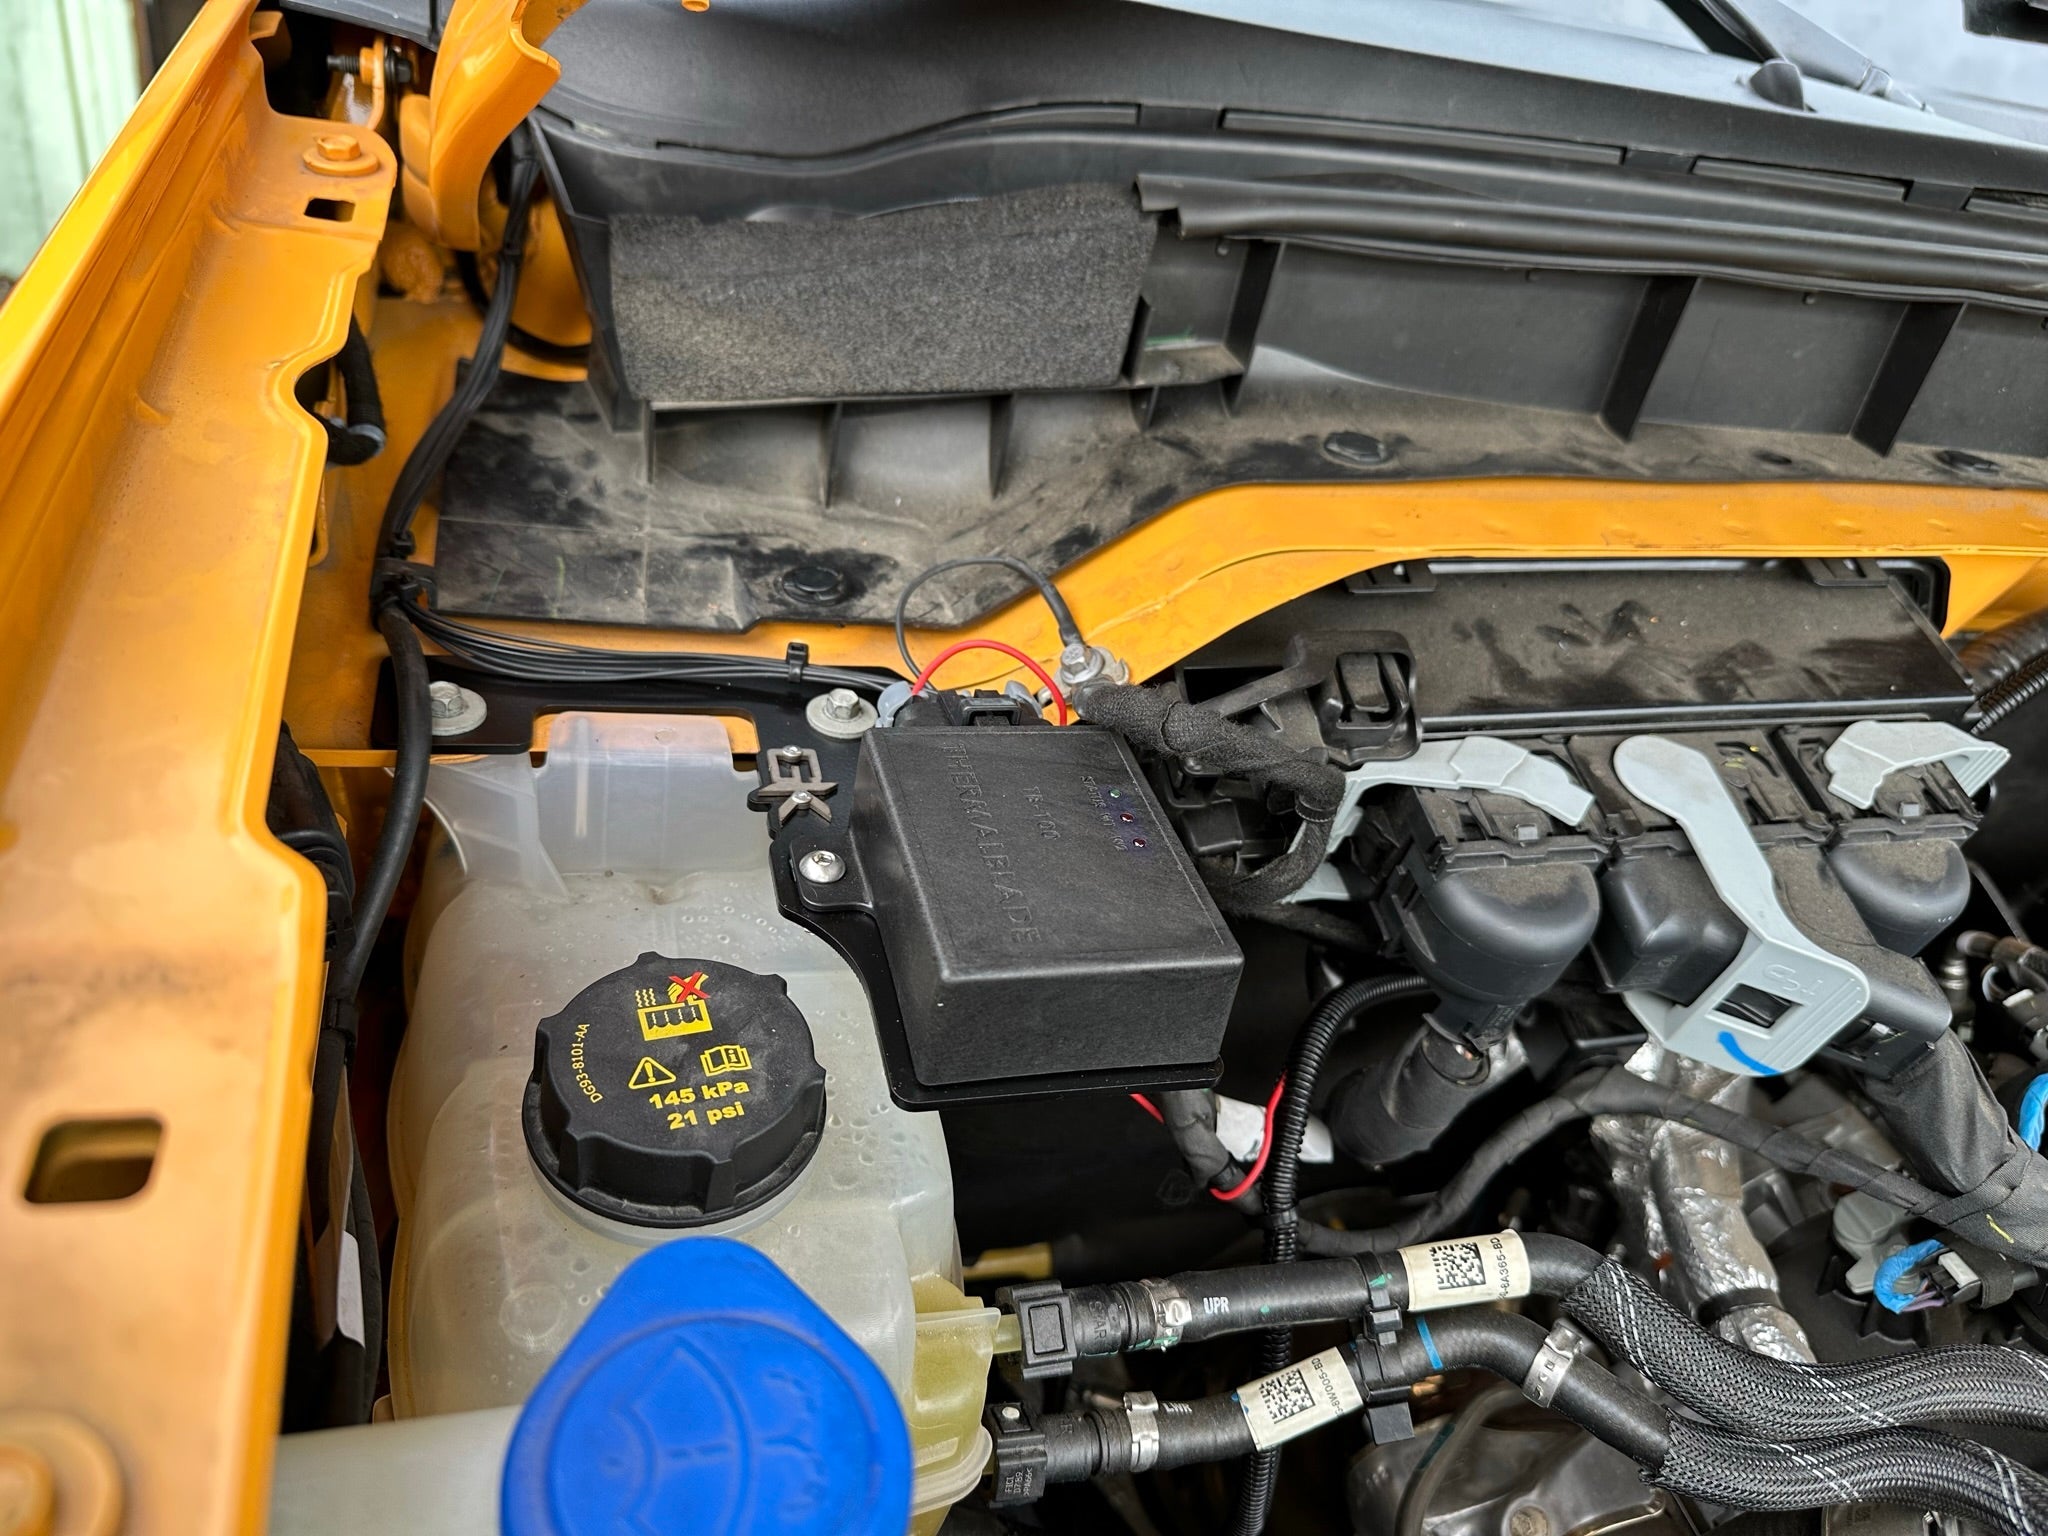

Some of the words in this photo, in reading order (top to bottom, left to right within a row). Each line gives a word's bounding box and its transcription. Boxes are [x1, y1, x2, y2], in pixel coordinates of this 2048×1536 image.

[942, 743, 1041, 942] THERMALBLADE
[571, 1023, 603, 1103] DG93-8101-AA
[649, 1088, 696, 1109] 145
[703, 1081, 750, 1100] kPa
[667, 1110, 698, 1130] 21
[707, 1102, 745, 1125] psi
[1203, 1297, 1229, 1315] UPR
